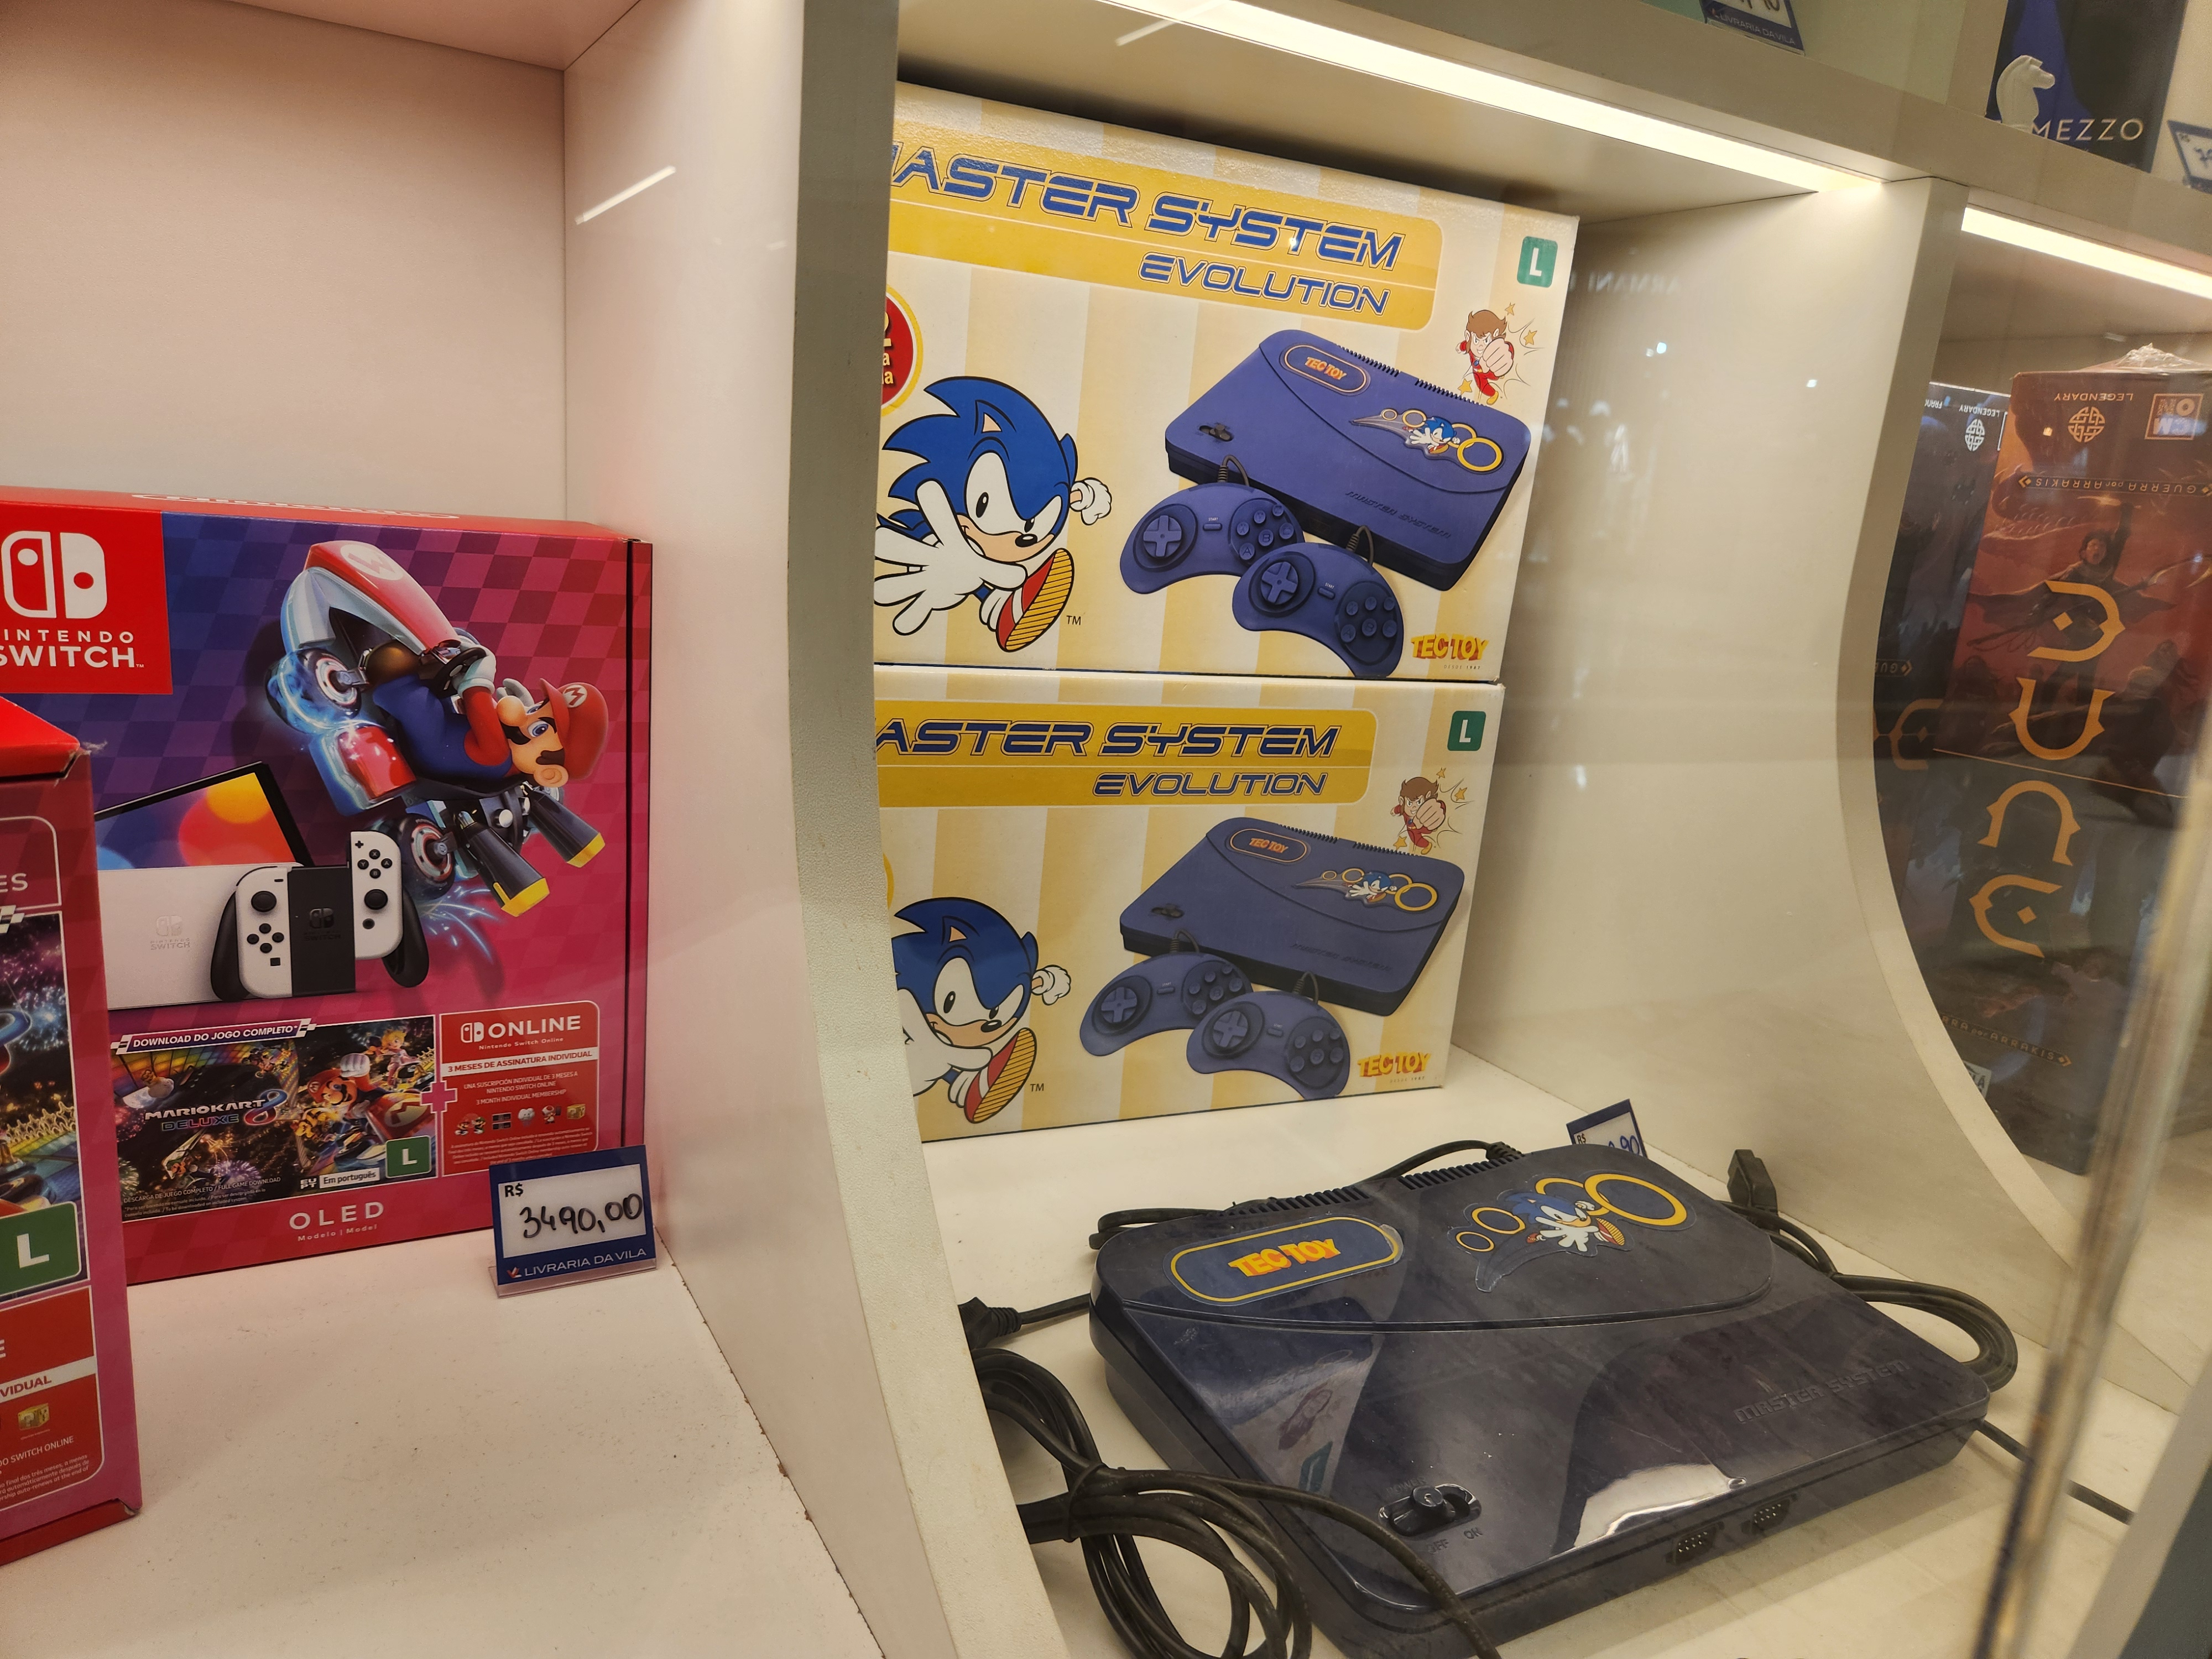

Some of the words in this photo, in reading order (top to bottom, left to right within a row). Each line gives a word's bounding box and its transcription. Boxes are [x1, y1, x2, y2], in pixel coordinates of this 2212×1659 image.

[1720, 13, 1761, 34] LIVRARIA
[1762, 28, 1775, 38] DA
[1775, 33, 1796, 45] VILA
[1144, 191, 1406, 272] SYSTEM
[1531, 247, 1543, 276] L
[1139, 252, 1391, 316] EVOLUTION
[1323, 364, 1347, 380] TOY
[2054, 392, 2133, 401] LEGENDARY
[1958, 404, 2000, 418] LEGENDARY
[2035, 478, 2102, 489] ARRAKIS
[2129, 483, 2196, 494] GUERRA
[1262, 534, 1271, 542] B
[1242, 547, 1251, 556] A
[1066, 615, 1081, 625] TM
[1411, 633, 1449, 659] TEC
[1450, 633, 1489, 661] TOY
[1098, 722, 1342, 759] SYSTEM
[1460, 719, 1472, 744] L
[1093, 772, 1328, 797] EVOLUTION
[488, 1015, 581, 1039] ONLINE
[133, 1035, 191, 1048] DOWNLOAD
[194, 1033, 209, 1042] DO
[211, 1030, 241, 1041] JOGO
[1991, 1032, 2056, 1060] ARRAKIS
[455, 1062, 483, 1072] MESES
[497, 1056, 547, 1067] ASSINATURA
[548, 1050, 593, 1061] INDIVIDUAL
[1357, 1052, 1394, 1077] TEC
[1395, 1052, 1432, 1073] TOY
[477, 1078, 512, 1088] SUSCRIPCIÓN
[513, 1075, 542, 1083] INDIVIDUAL
[486, 1086, 515, 1094] NINTENDO
[1030, 1083, 1044, 1092] TM
[501, 1093, 532, 1102] INDIVIDUAL
[532, 1089, 567, 1099] MEMBERSHIP
[244, 1089, 288, 1125] 8
[161, 1114, 239, 1131] DELUXE
[1577, 1133, 1587, 1144] R$
[402, 1149, 418, 1165] L
[337, 1171, 377, 1184] português
[124, 1194, 154, 1203] DESCARGA
[183, 1186, 213, 1195] COMPLETO
[249, 1177, 281, 1186] DOWNLOAD
[504, 1182, 524, 1198] R$
[289, 1201, 384, 1230] OLED
[519, 1193, 643, 1239] 3490,00
[298, 1231, 336, 1241] Modelo
[346, 1224, 378, 1234] Model
[17, 1233, 50, 1269] L
[1228, 1249, 1292, 1277] TEC
[1277, 1238, 1342, 1265] TOY
[524, 1258, 591, 1277] LIVRARIA
[594, 1253, 614, 1264] DA
[614, 1248, 647, 1260] VILA
[1733, 1385, 1824, 1423] MASTER
[1828, 1358, 1911, 1394] SYSTEM
[11, 1446, 43, 1463] SWITCH
[44, 1436, 74, 1452] ONLINE
[6, 1477, 19, 1486] final
[32, 1469, 43, 1478] três
[69, 1454, 88, 1464] menos
[1463, 1527, 1484, 1540] ON
[1426, 1538, 1449, 1554] OFF
